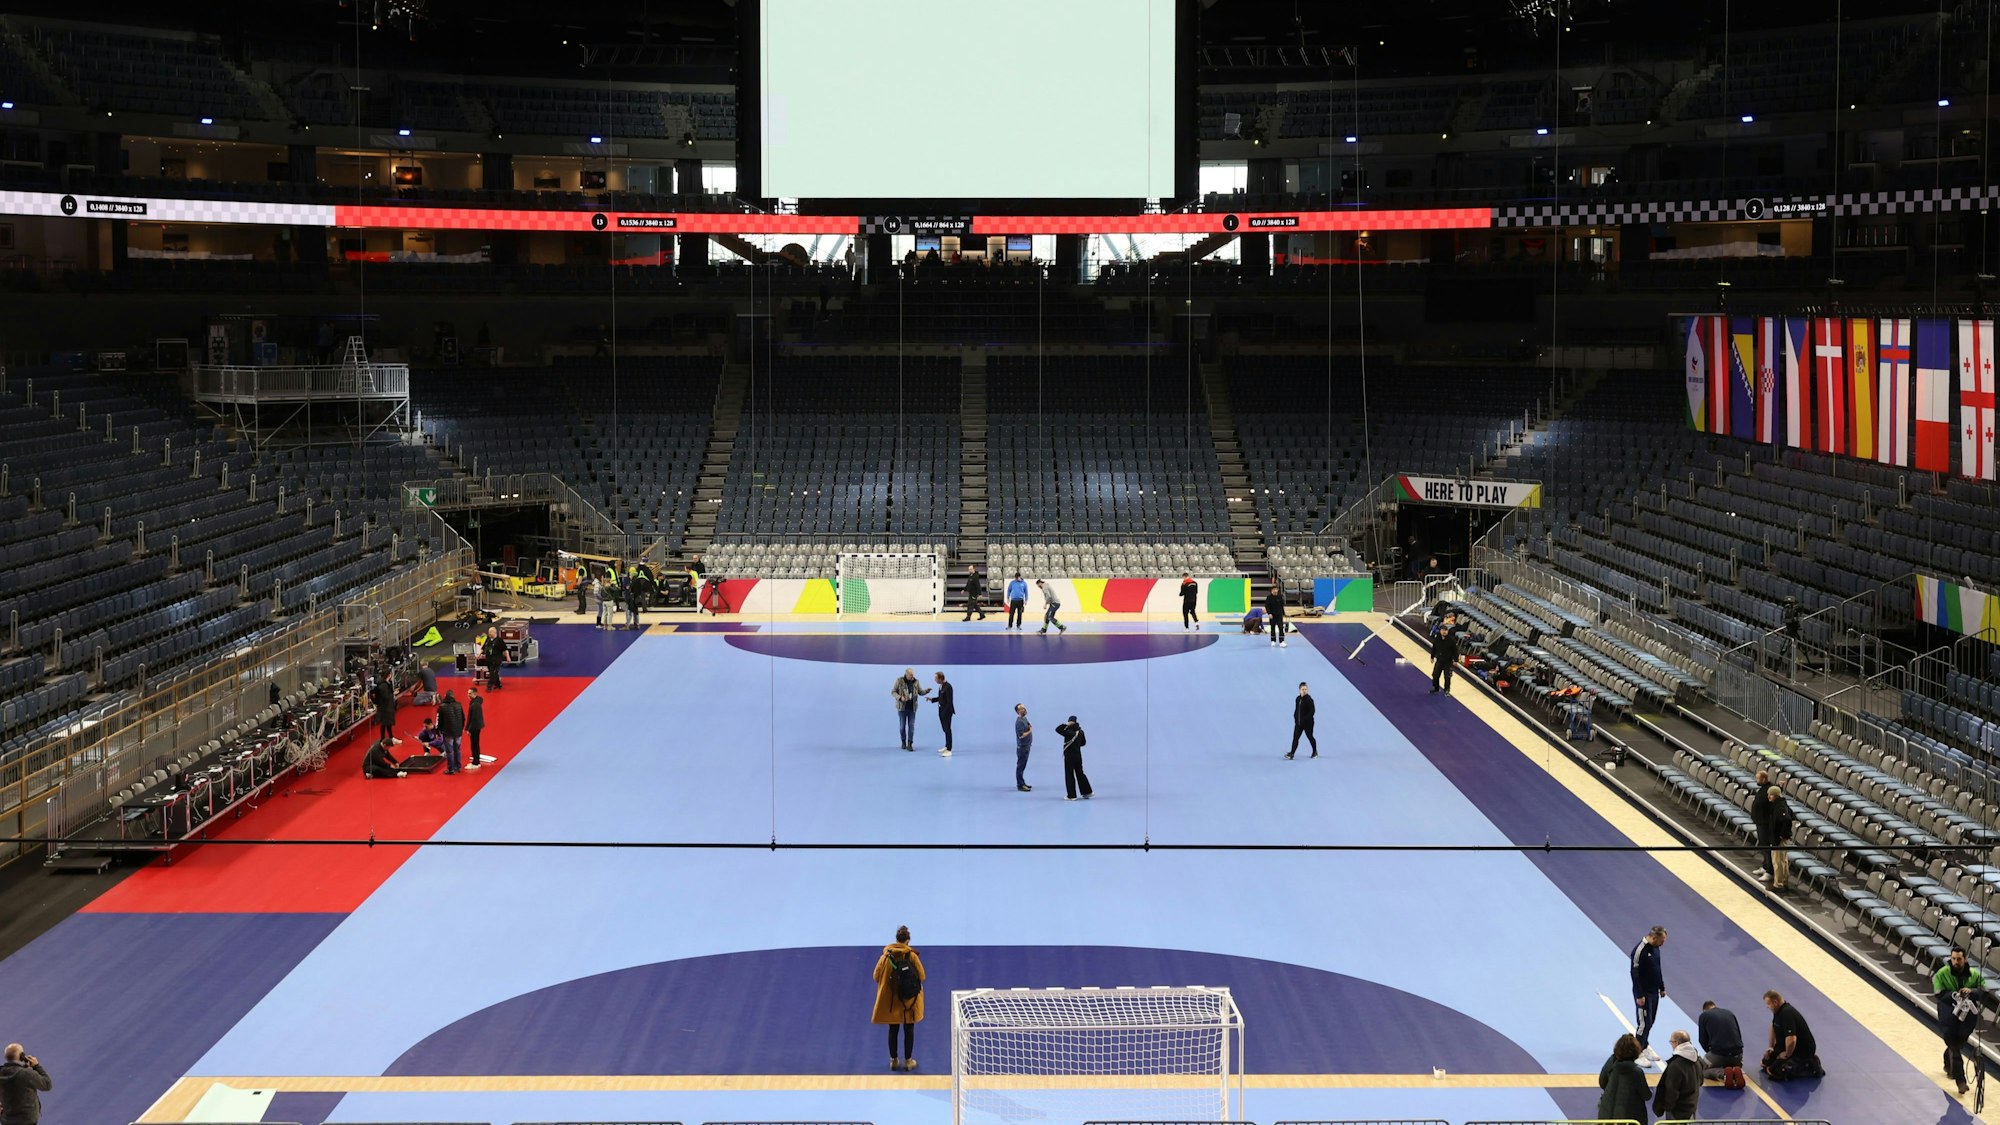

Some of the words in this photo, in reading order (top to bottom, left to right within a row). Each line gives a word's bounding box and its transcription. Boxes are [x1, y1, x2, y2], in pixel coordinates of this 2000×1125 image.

[1425, 482, 1454, 500] HERE
[1459, 484, 1473, 502] TO
[1477, 485, 1507, 504] PLAY
